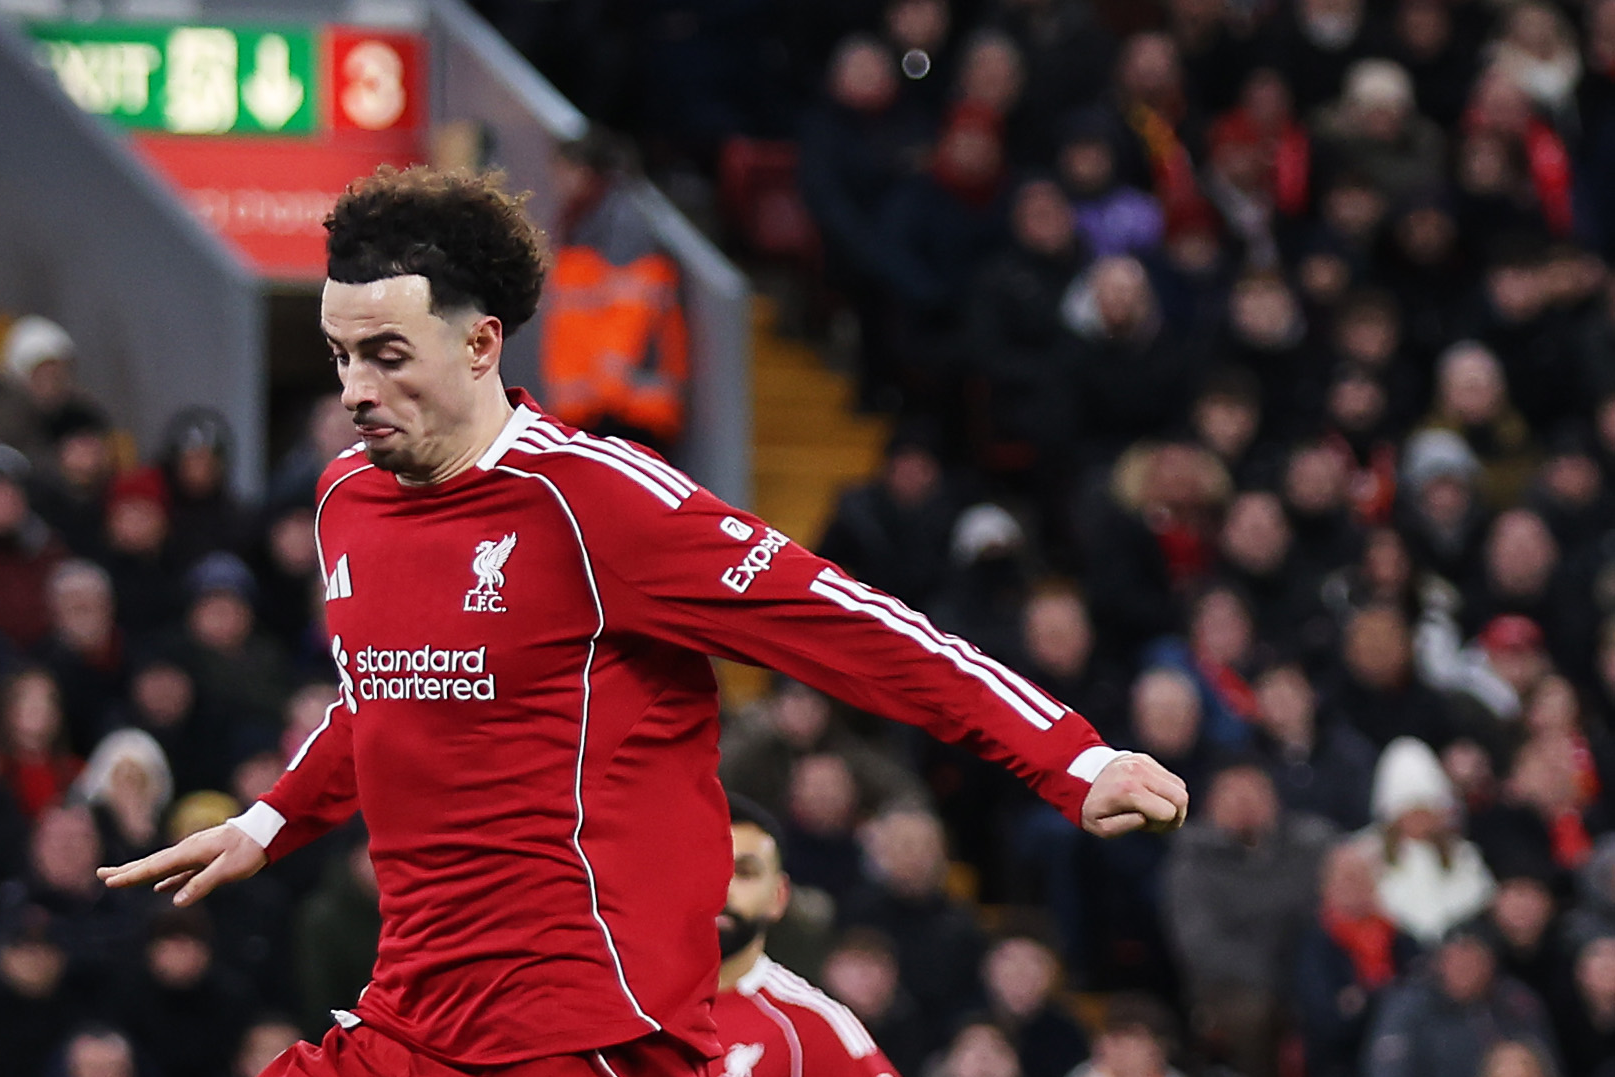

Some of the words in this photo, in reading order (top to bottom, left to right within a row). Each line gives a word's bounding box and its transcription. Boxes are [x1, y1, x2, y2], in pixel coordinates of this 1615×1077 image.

[45, 42, 162, 114] XIT
[341, 40, 406, 131] 3
[356, 644, 486, 673] standard
[359, 672, 496, 700] chartered
